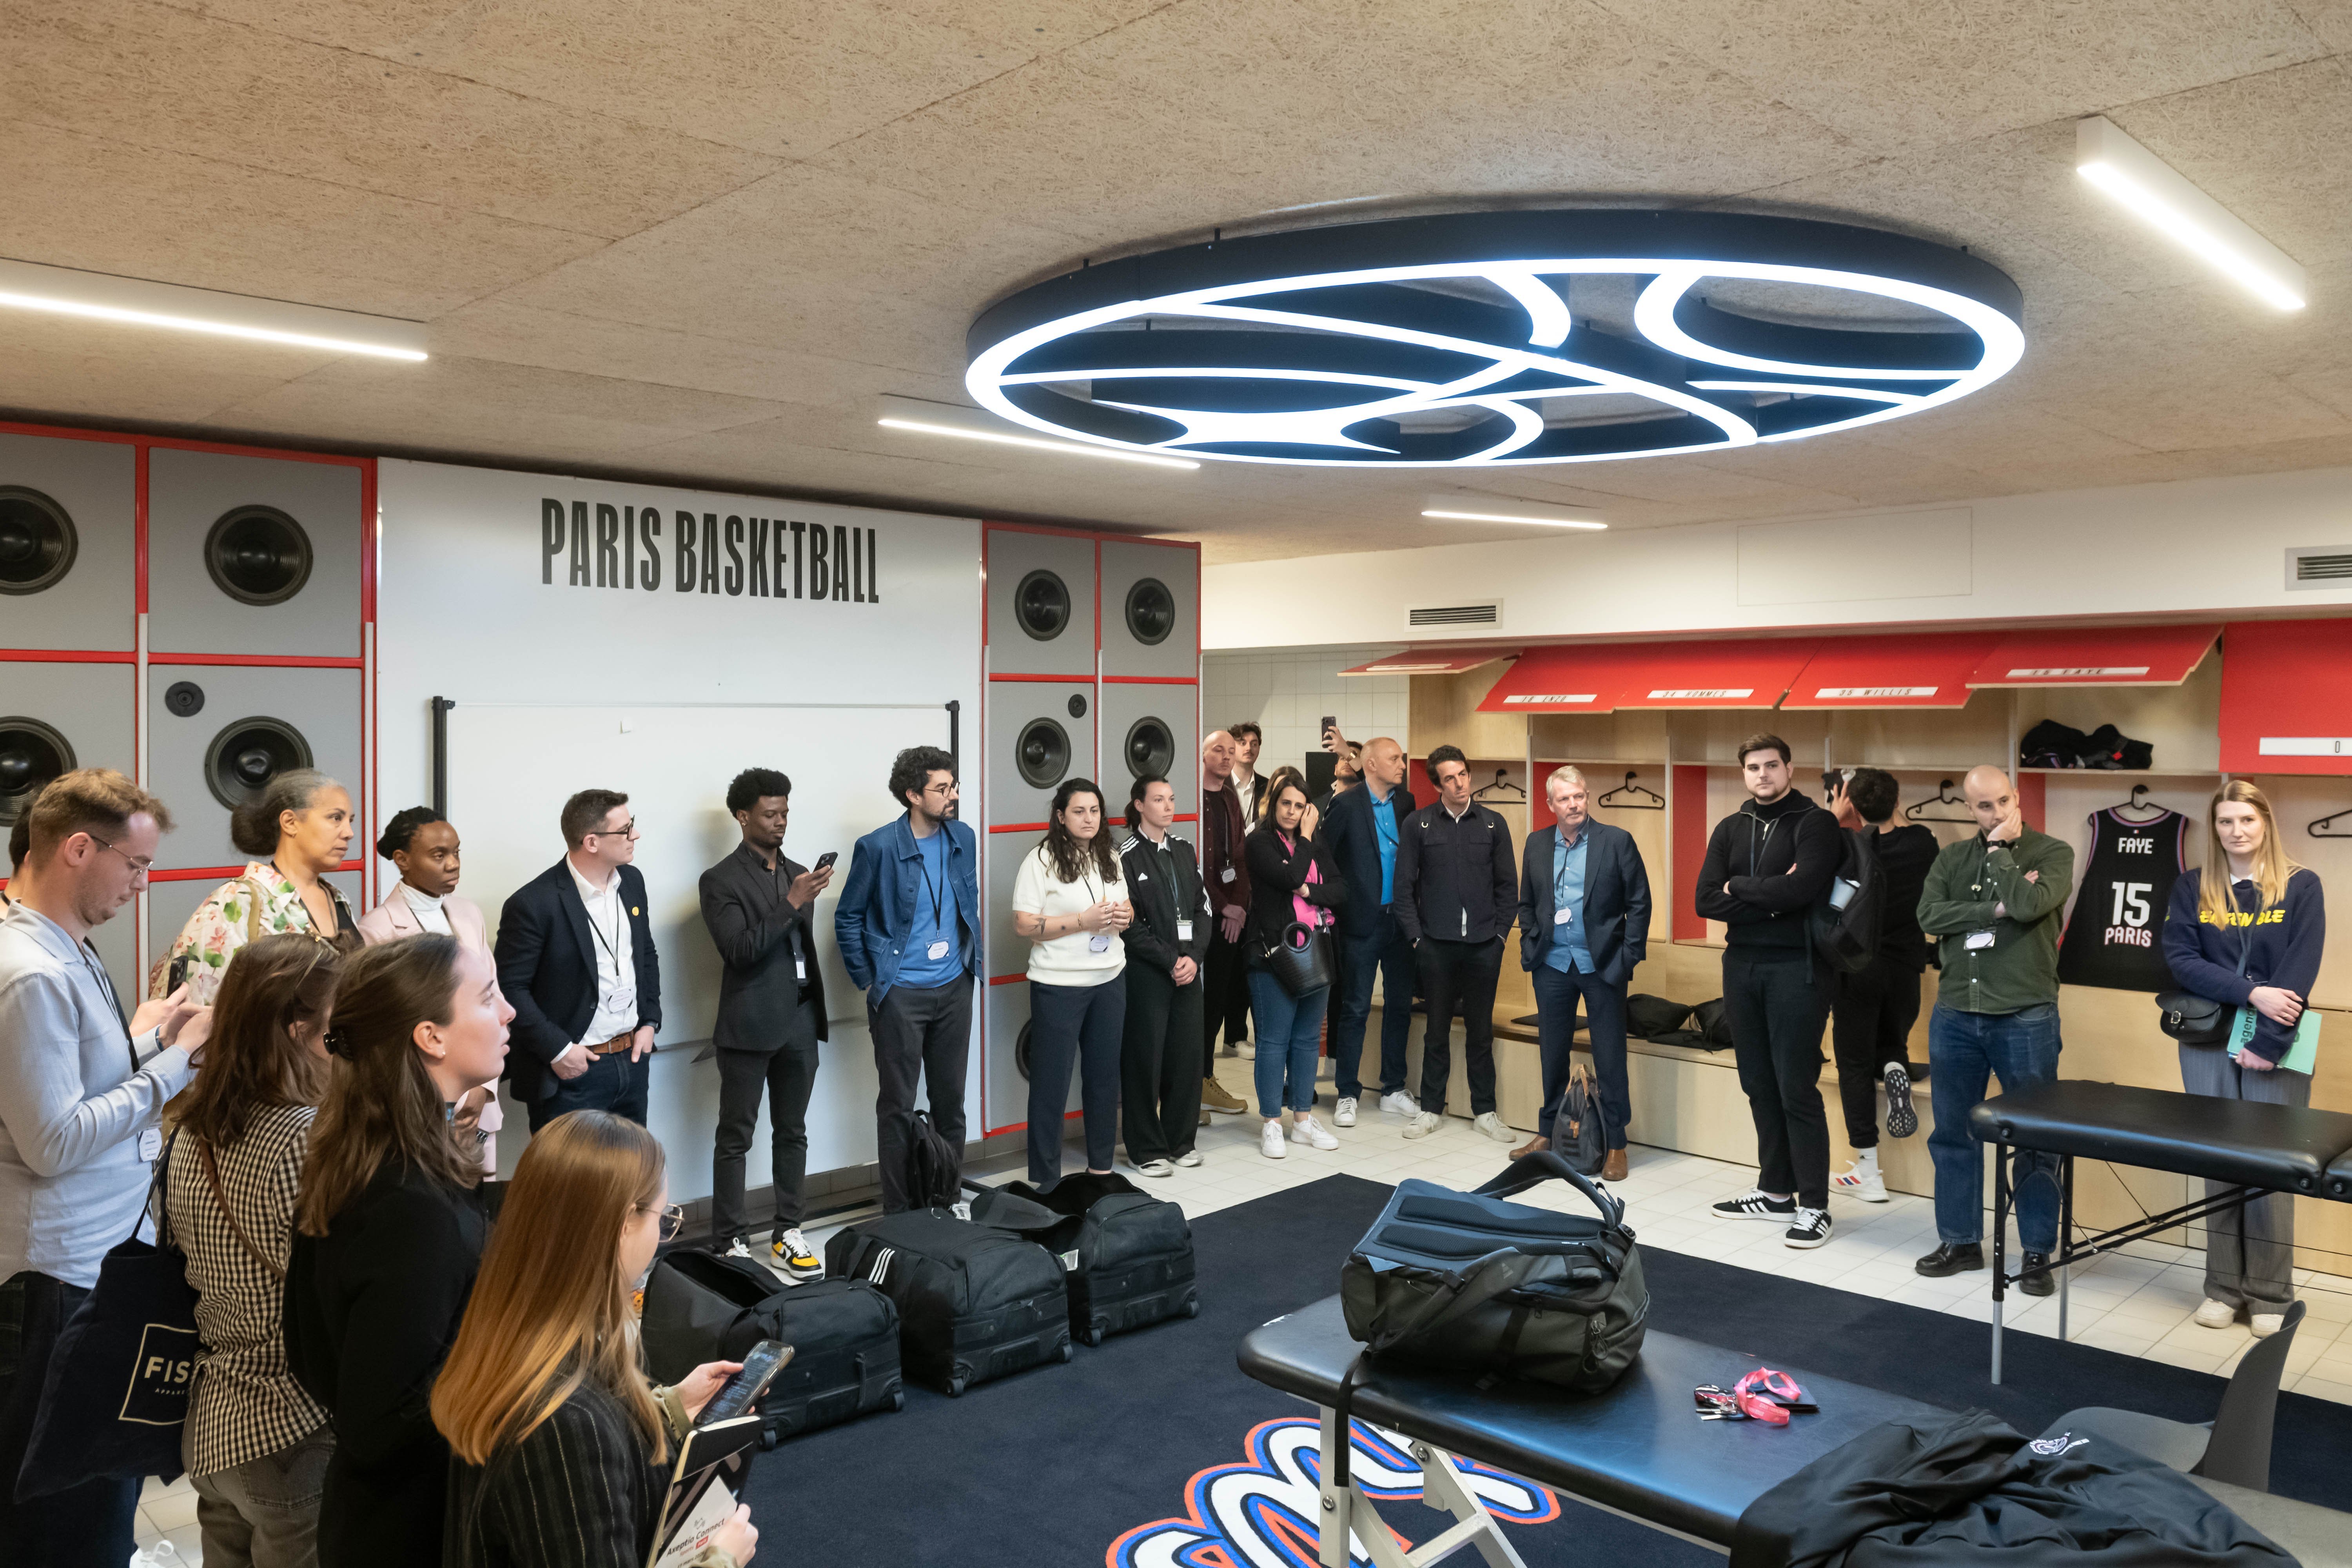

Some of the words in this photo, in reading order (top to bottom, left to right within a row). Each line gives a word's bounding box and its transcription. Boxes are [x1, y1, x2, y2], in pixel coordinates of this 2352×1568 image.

[541, 498, 661, 591] PARIS
[675, 510, 879, 604] BASKETBALL
[1863, 688, 1912, 696] WILLIS
[2118, 837, 2154, 854] FAYE
[2112, 881, 2152, 927] 15
[2104, 926, 2153, 948] PARIS
[144, 1356, 191, 1383] FIS
[667, 1536, 694, 1557] Axeptio
[696, 1518, 725, 1540] Connect
